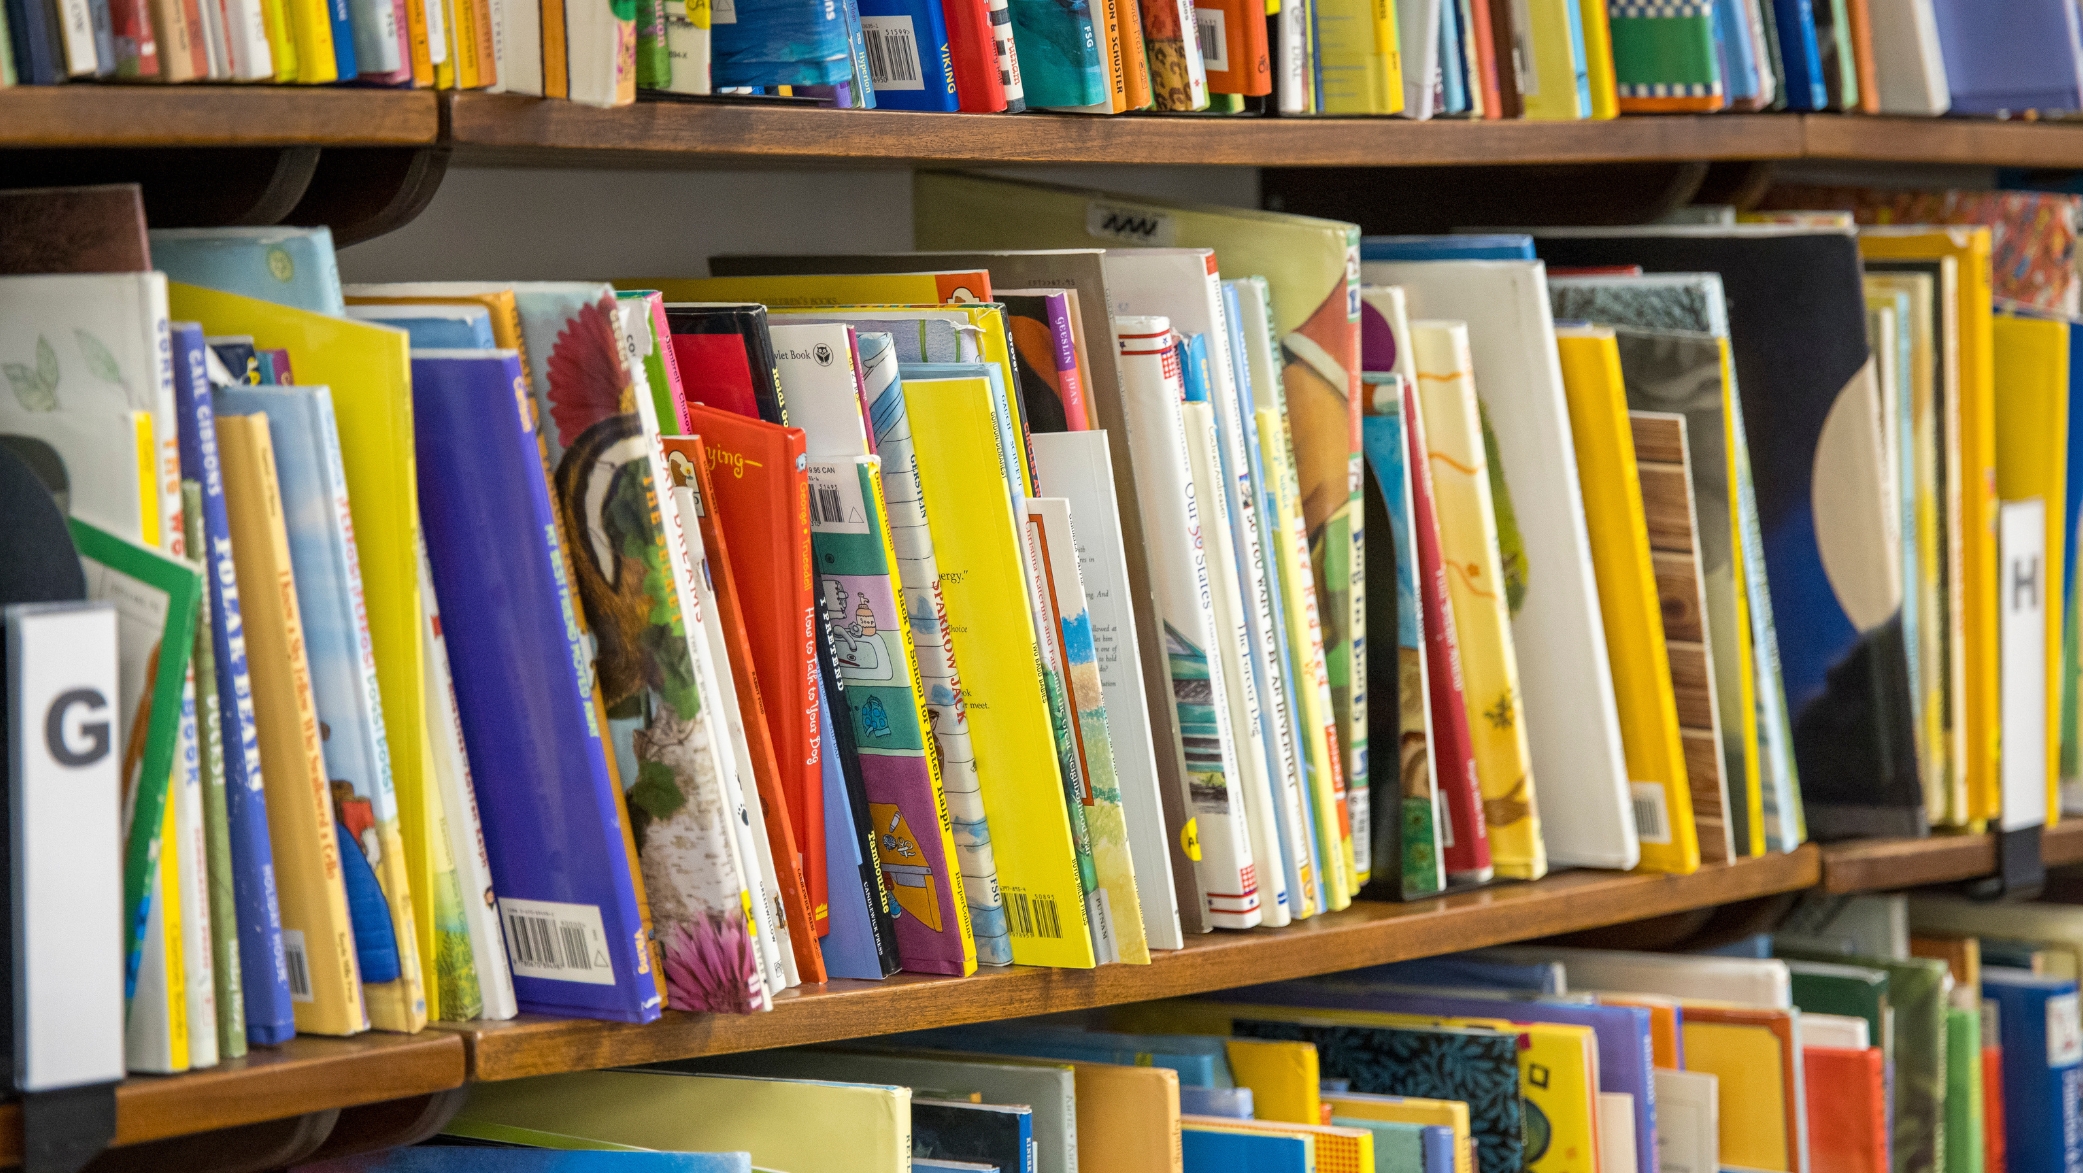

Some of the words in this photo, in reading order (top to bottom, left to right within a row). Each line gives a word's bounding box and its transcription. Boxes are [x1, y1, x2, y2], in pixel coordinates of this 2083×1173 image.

[1084, 25, 1093, 47] FSG
[1109, 23, 1117, 32] &
[856, 50, 873, 94] Hyperion
[940, 42, 956, 94] VIKING
[1109, 36, 1124, 94] SCHUSTER
[188, 347, 207, 399] GAIL
[790, 349, 812, 360] Book
[1054, 316, 1072, 364] GEESLIN
[1065, 375, 1079, 405] JUAN
[771, 366, 785, 407] Heidi
[195, 404, 220, 497] GIBBONS
[1021, 421, 1038, 475] CIRCLES
[641, 475, 662, 526] THE
[797, 481, 809, 526] George
[1183, 481, 1199, 521] Our
[1023, 519, 1039, 571] Christina
[1187, 523, 1204, 551] 50
[800, 537, 812, 591] Truesdell
[1193, 553, 1213, 610] States
[2012, 556, 2040, 612] H
[213, 534, 246, 663] POLAR
[1033, 574, 1049, 622] Katerina
[1096, 590, 1109, 598] And
[803, 606, 815, 638] How
[805, 639, 814, 654] to
[510, 374, 533, 433] Carlson
[632, 927, 649, 975] Viking
[805, 653, 818, 685] Talk
[807, 686, 817, 702] to
[909, 453, 927, 519] GERSTEIN
[931, 579, 956, 670] SPARROW
[949, 675, 967, 725] JACK
[989, 878, 1001, 903] FSG
[1235, 621, 1249, 649] The
[1246, 707, 1263, 738] Dog
[44, 686, 112, 770] G
[233, 673, 263, 793] BEARS
[805, 701, 820, 734] Your
[1059, 715, 1072, 750] Great
[805, 735, 821, 765] Dog
[821, 611, 844, 691] PRETEND
[864, 831, 891, 914] Tambourine
[895, 587, 909, 625] Back
[907, 648, 924, 700] School
[918, 702, 929, 724] for
[924, 729, 941, 782] Rotten
[934, 786, 951, 833] Ralph
[952, 871, 972, 939] HarperCollins
[1065, 754, 1088, 834] Neighborhood
[1081, 834, 1092, 856] War
[862, 881, 878, 932] CANDLEWICK
[873, 933, 883, 955] PRESS
[1094, 897, 1108, 940] PUTNAM
[904, 1134, 912, 1172] KELL
